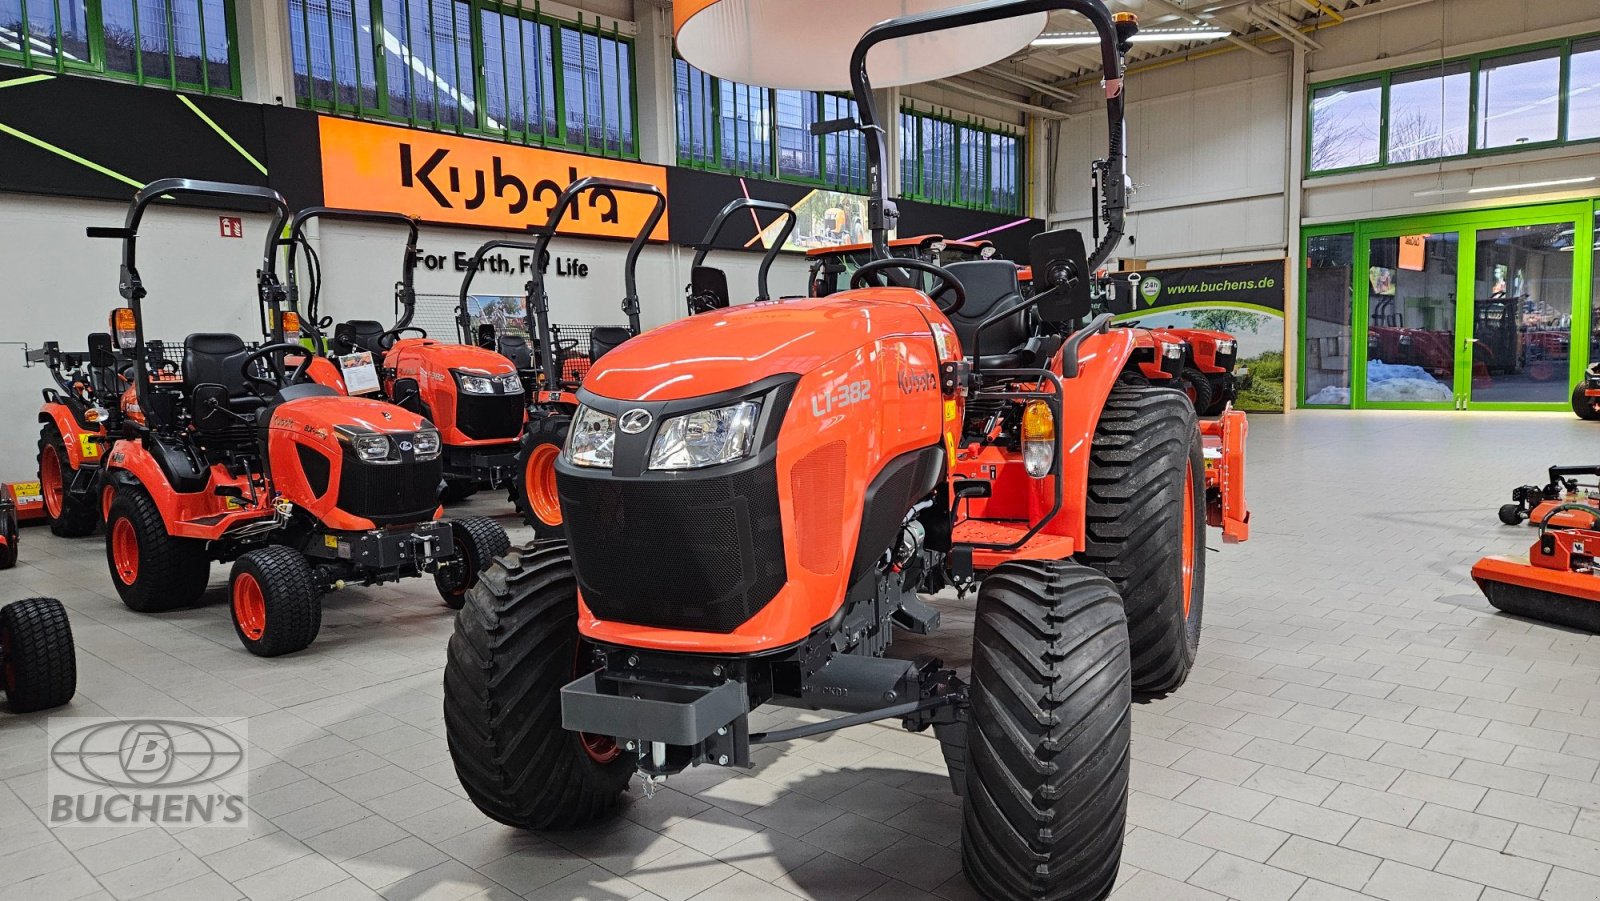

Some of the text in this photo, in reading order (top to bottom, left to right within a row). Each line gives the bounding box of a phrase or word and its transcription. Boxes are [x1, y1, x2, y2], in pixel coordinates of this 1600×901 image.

[399, 142, 618, 224] Kubota
[519, 254, 549, 275] Fr
[556, 257, 589, 277] Life
[1144, 281, 1158, 289] 24h
[1167, 277, 1275, 294] www.buchens.de
[897, 368, 937, 395] Kubota
